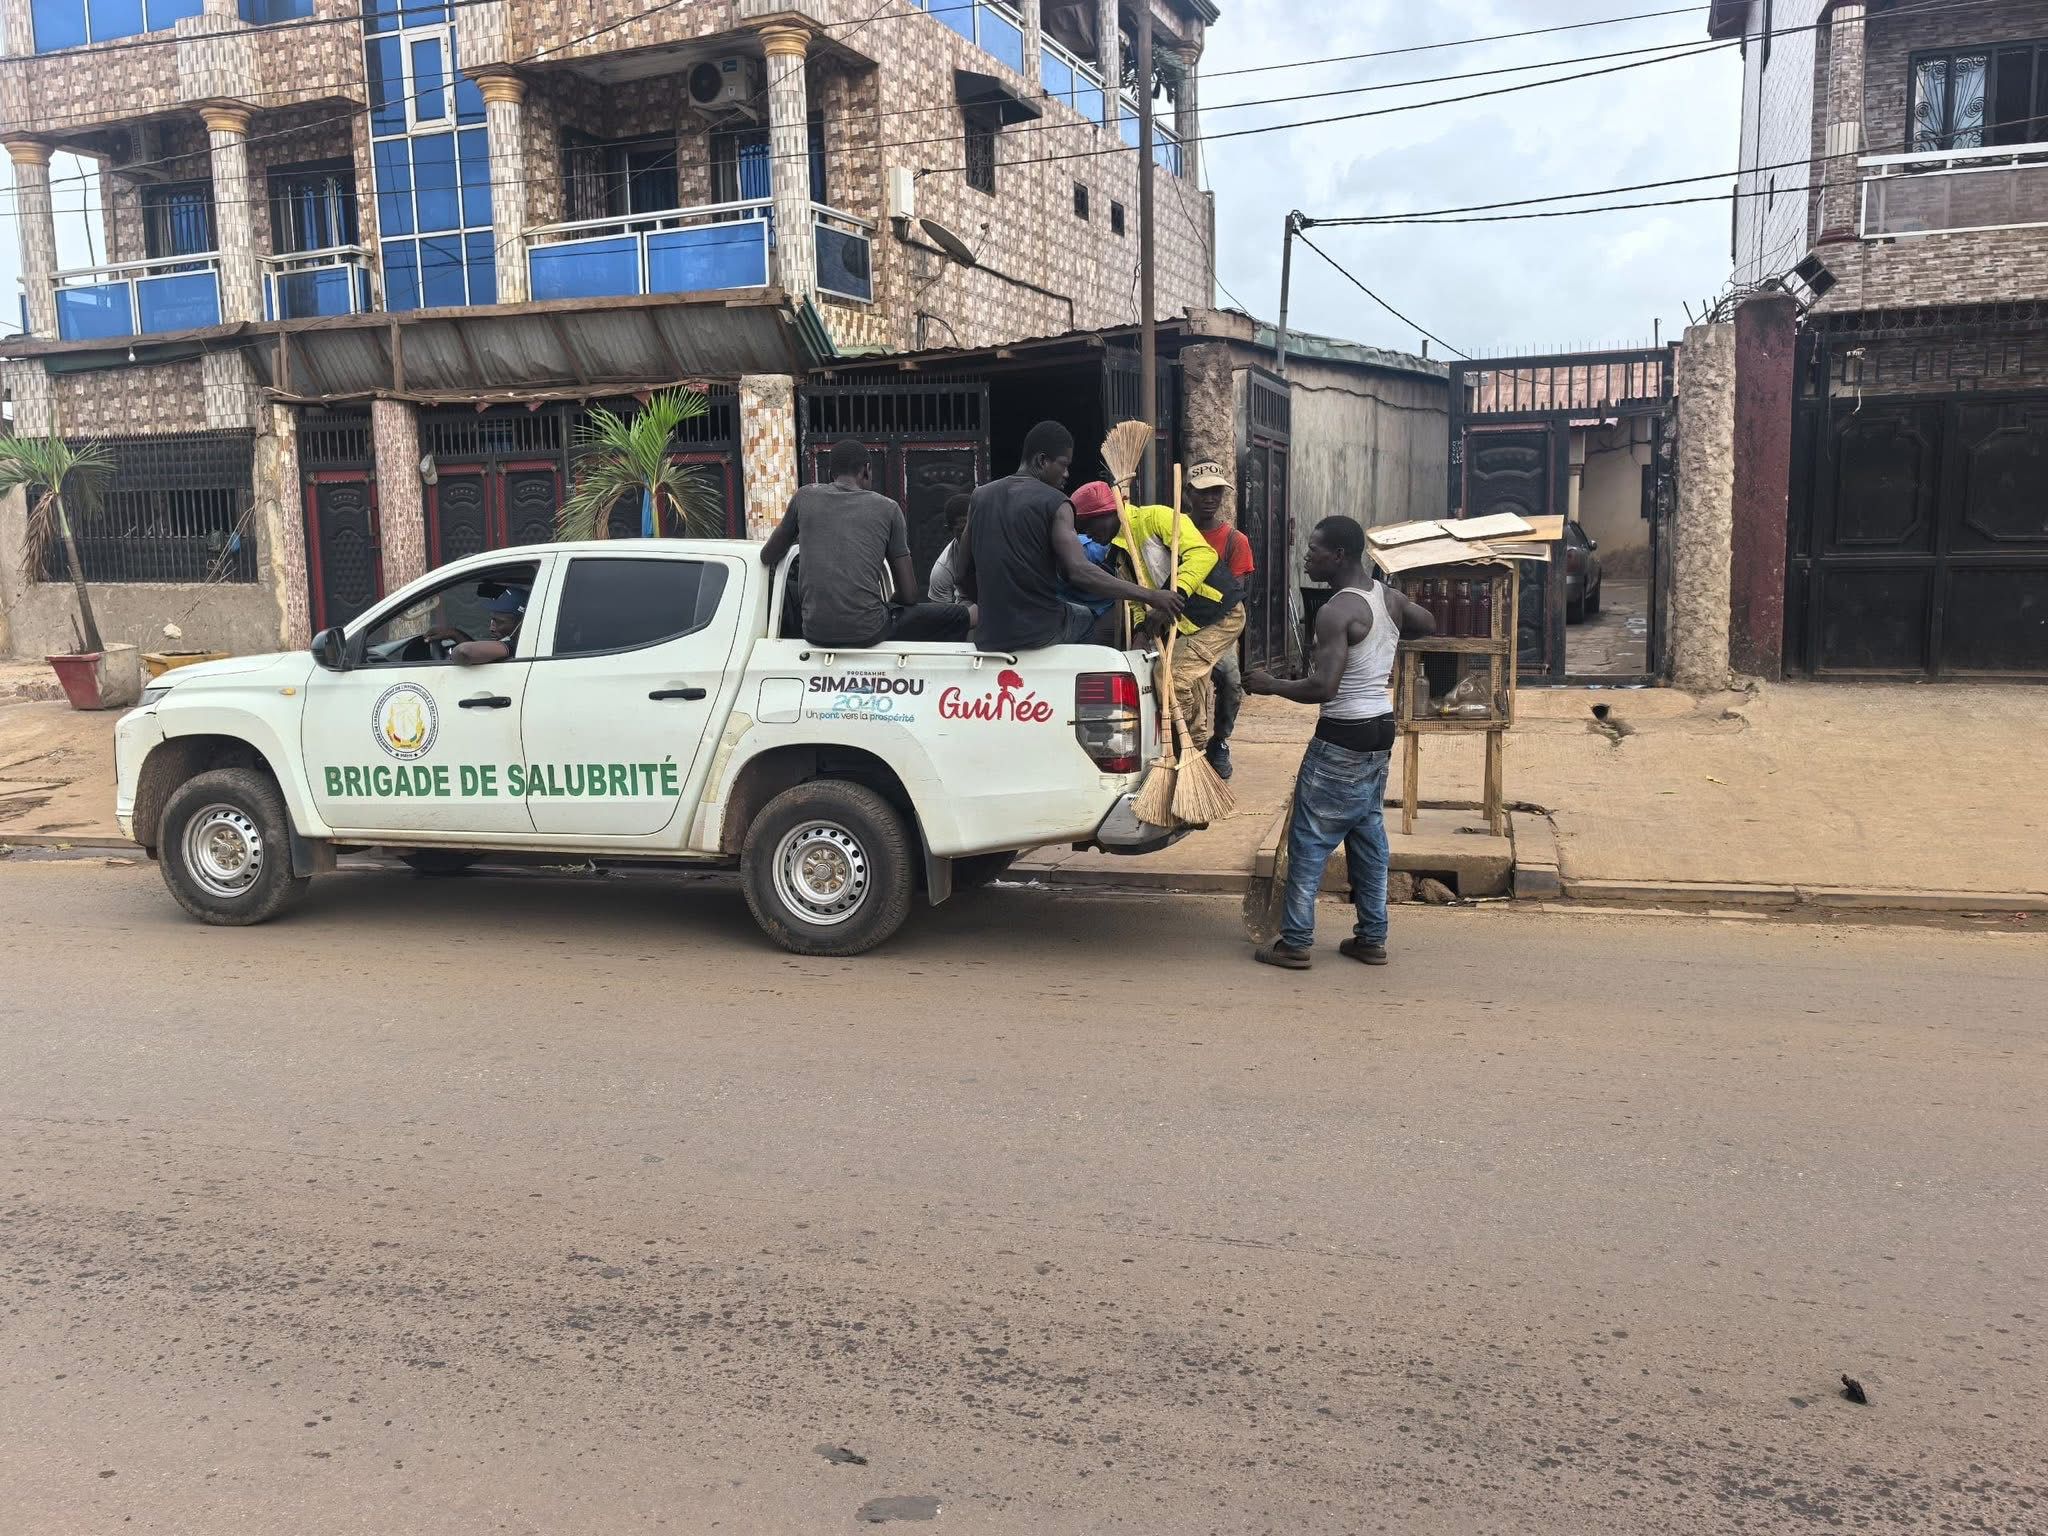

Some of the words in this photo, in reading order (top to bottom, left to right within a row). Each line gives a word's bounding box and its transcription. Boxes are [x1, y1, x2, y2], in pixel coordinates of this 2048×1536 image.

[808, 676, 924, 696] SIMANDOU
[832, 694, 893, 713] 2040
[939, 687, 1054, 722] Guinée
[805, 711, 819, 719] Un
[819, 711, 841, 721] pont
[859, 711, 868, 720] la
[869, 712, 915, 723] prospérité
[324, 765, 451, 797] BRIGADE
[459, 764, 498, 797] DE
[507, 755, 680, 797] SALUBRITÉ
